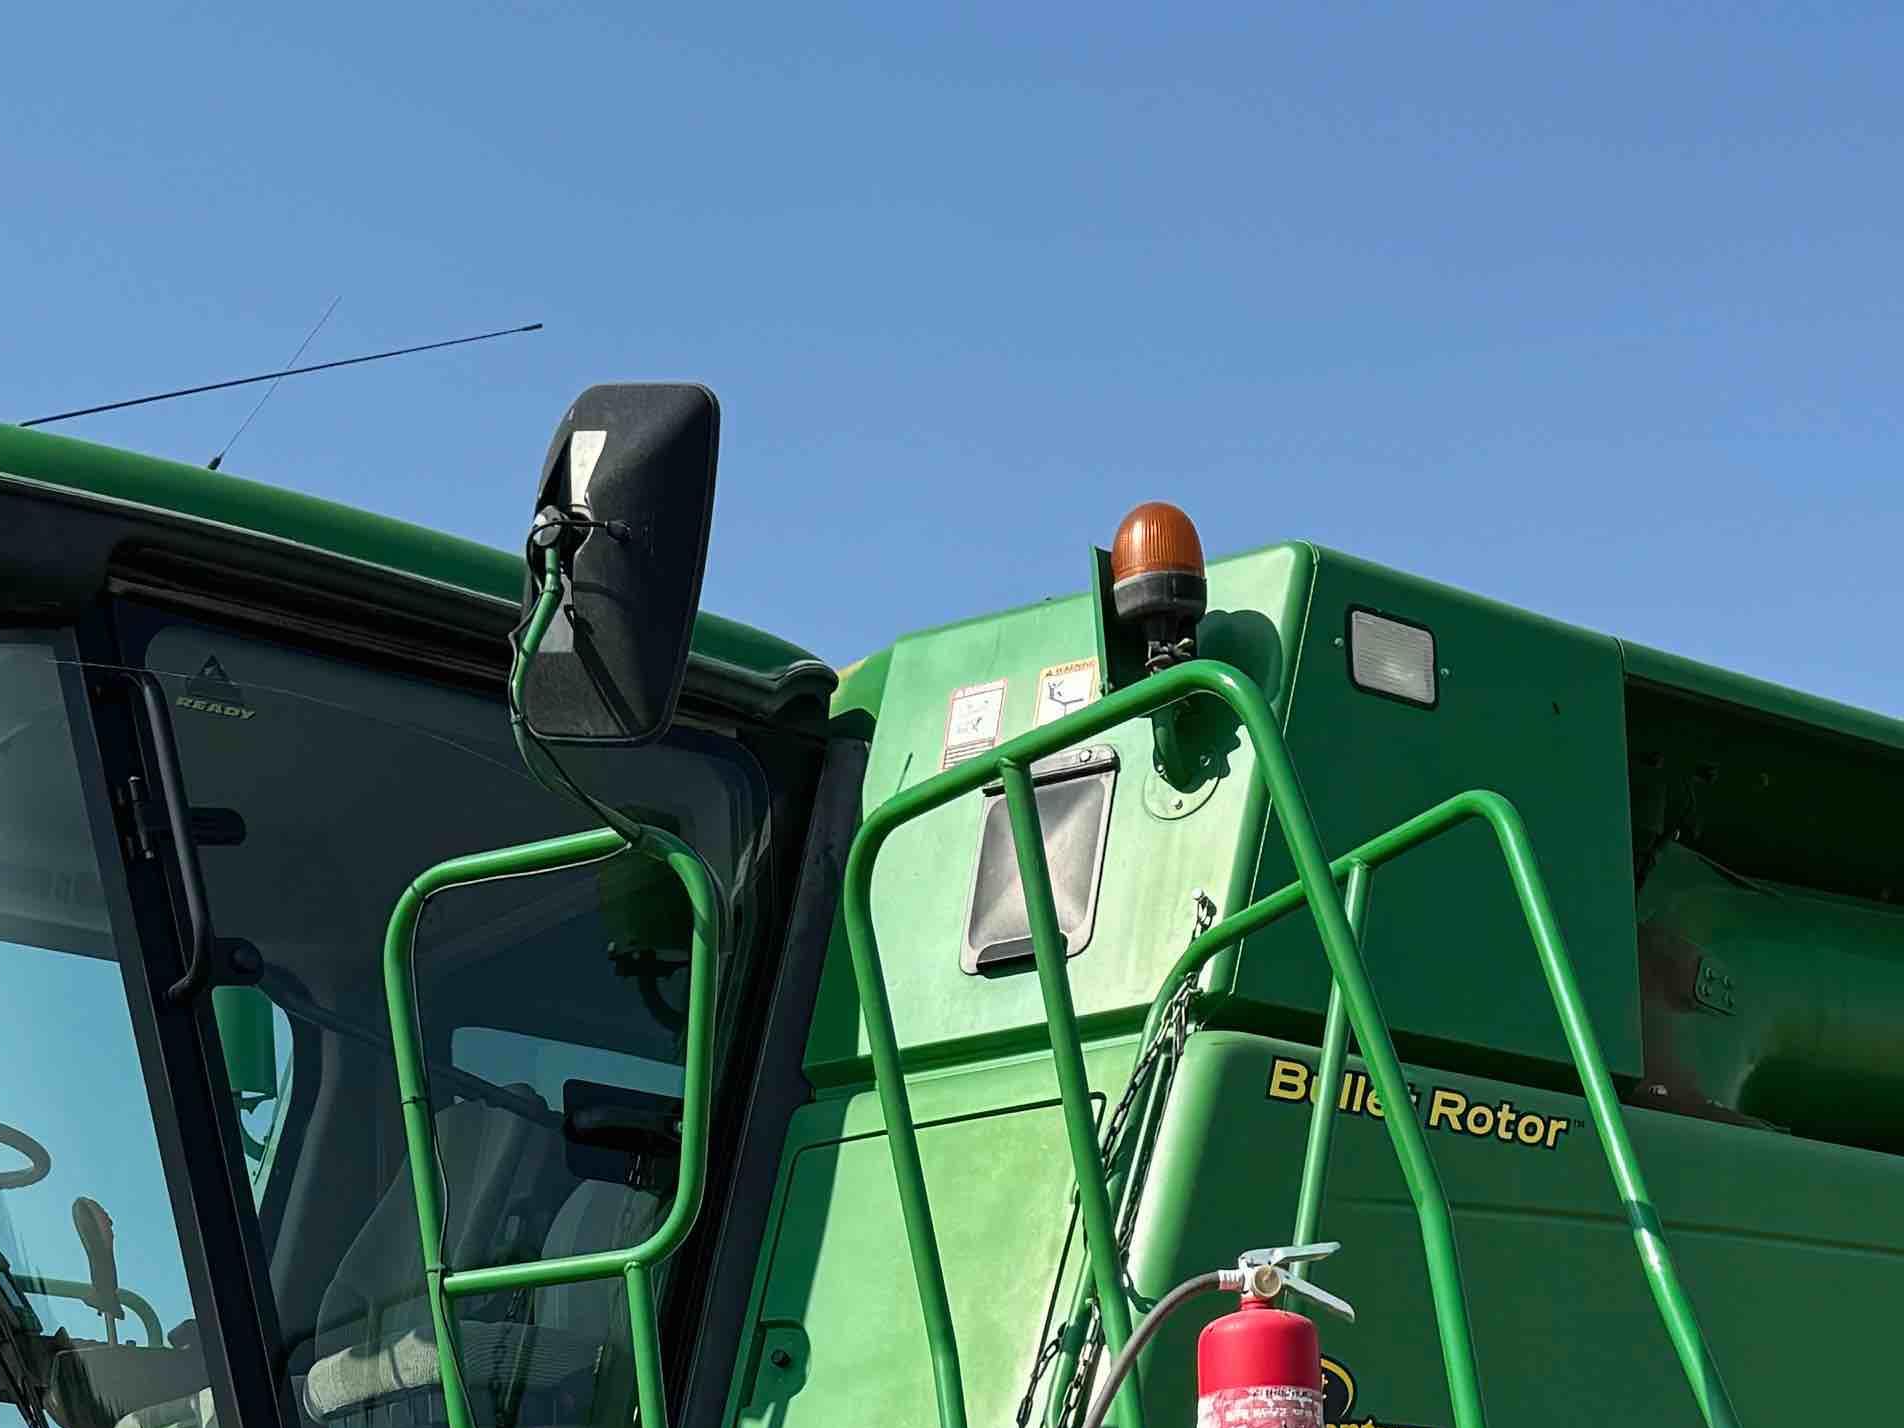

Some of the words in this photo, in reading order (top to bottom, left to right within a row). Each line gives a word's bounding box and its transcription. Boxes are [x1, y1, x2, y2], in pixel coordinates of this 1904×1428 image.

[176, 696, 256, 720] READY
[1269, 1058, 1416, 1117] Blle
[1428, 1089, 1569, 1148] Rotor
